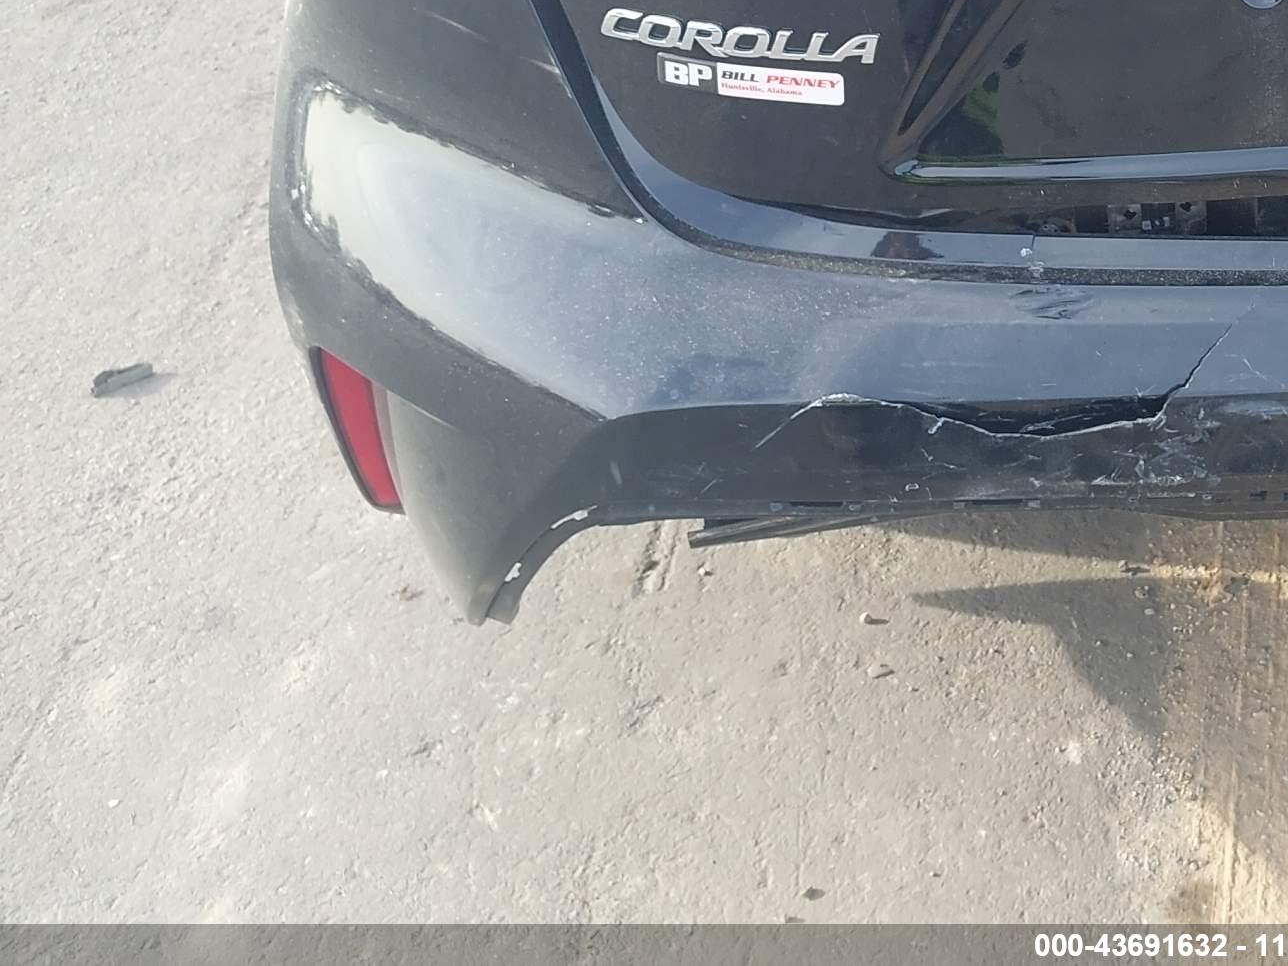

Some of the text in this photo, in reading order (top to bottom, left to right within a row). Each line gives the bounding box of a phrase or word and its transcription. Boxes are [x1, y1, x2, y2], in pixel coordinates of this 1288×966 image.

[601, 8, 880, 64] COROLLA
[664, 60, 713, 87] BP
[721, 70, 840, 89] BILL PENNEY
[766, 87, 803, 96] Alabama
